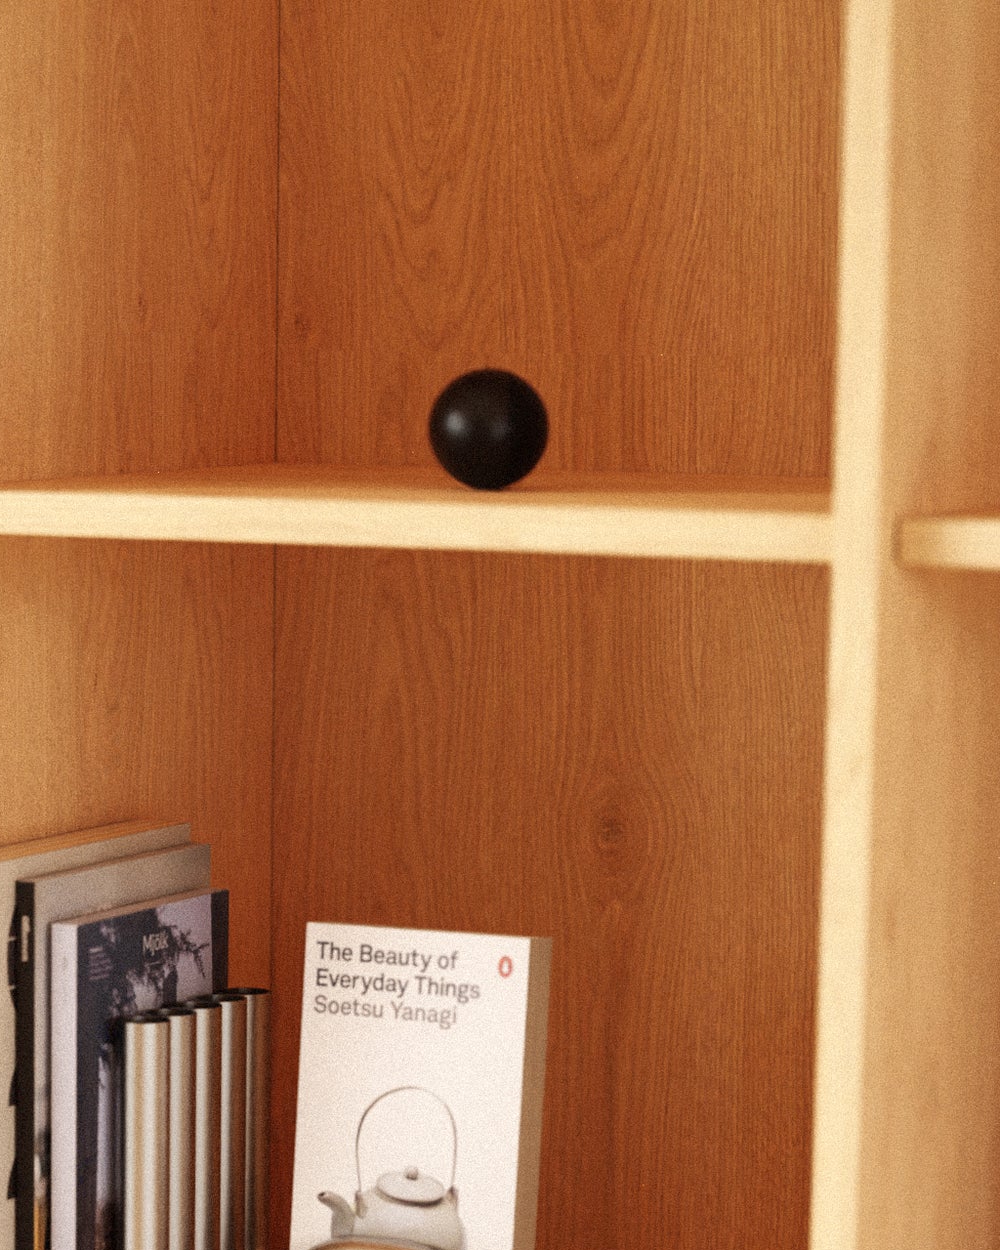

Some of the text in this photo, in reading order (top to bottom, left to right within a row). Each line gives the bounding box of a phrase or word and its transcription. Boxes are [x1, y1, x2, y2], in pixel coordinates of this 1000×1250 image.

[317, 940, 459, 972] The Beauty of
[316, 968, 480, 1003] Everyday Things
[314, 995, 457, 1030] Soetsu Yanagi
